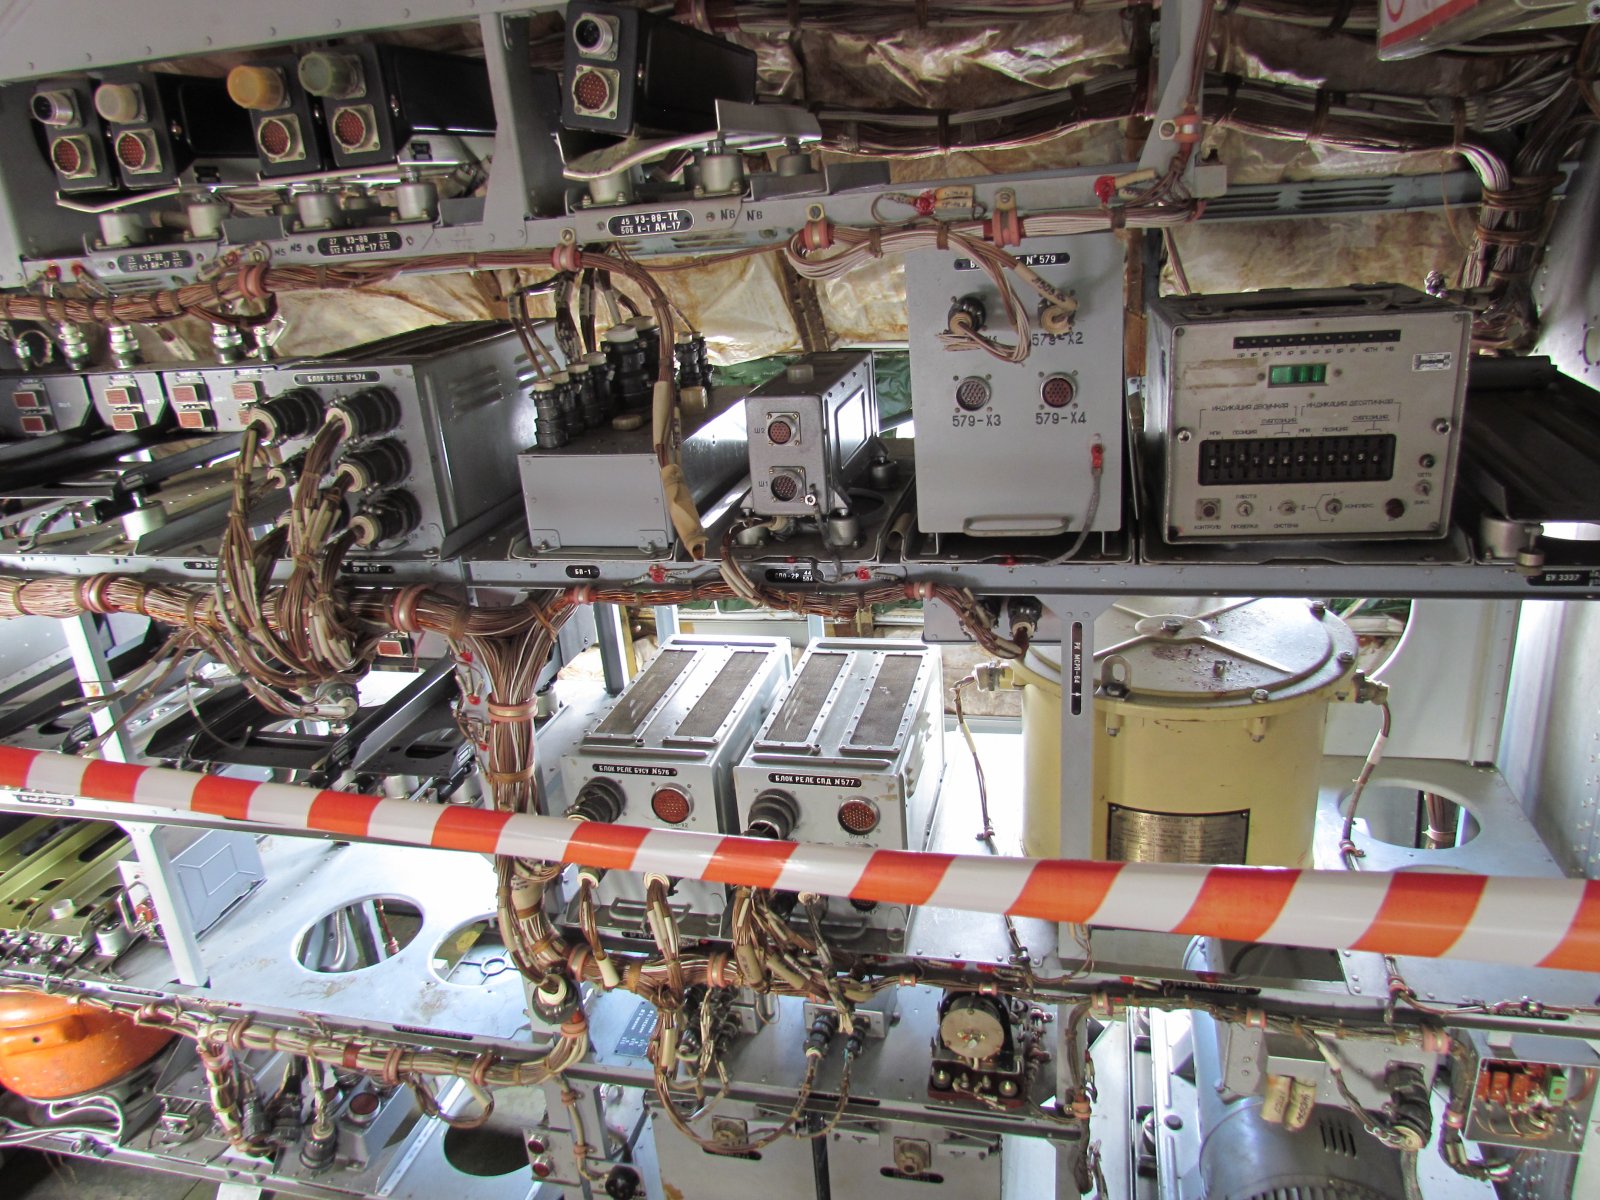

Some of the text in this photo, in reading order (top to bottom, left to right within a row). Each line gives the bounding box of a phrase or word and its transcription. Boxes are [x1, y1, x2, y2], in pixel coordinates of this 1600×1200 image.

[620, 218, 630, 226] 45
[620, 226, 634, 234] 506
[655, 221, 681, 232] АИ-17
[795, 776, 815, 784] РЕЛЕ
